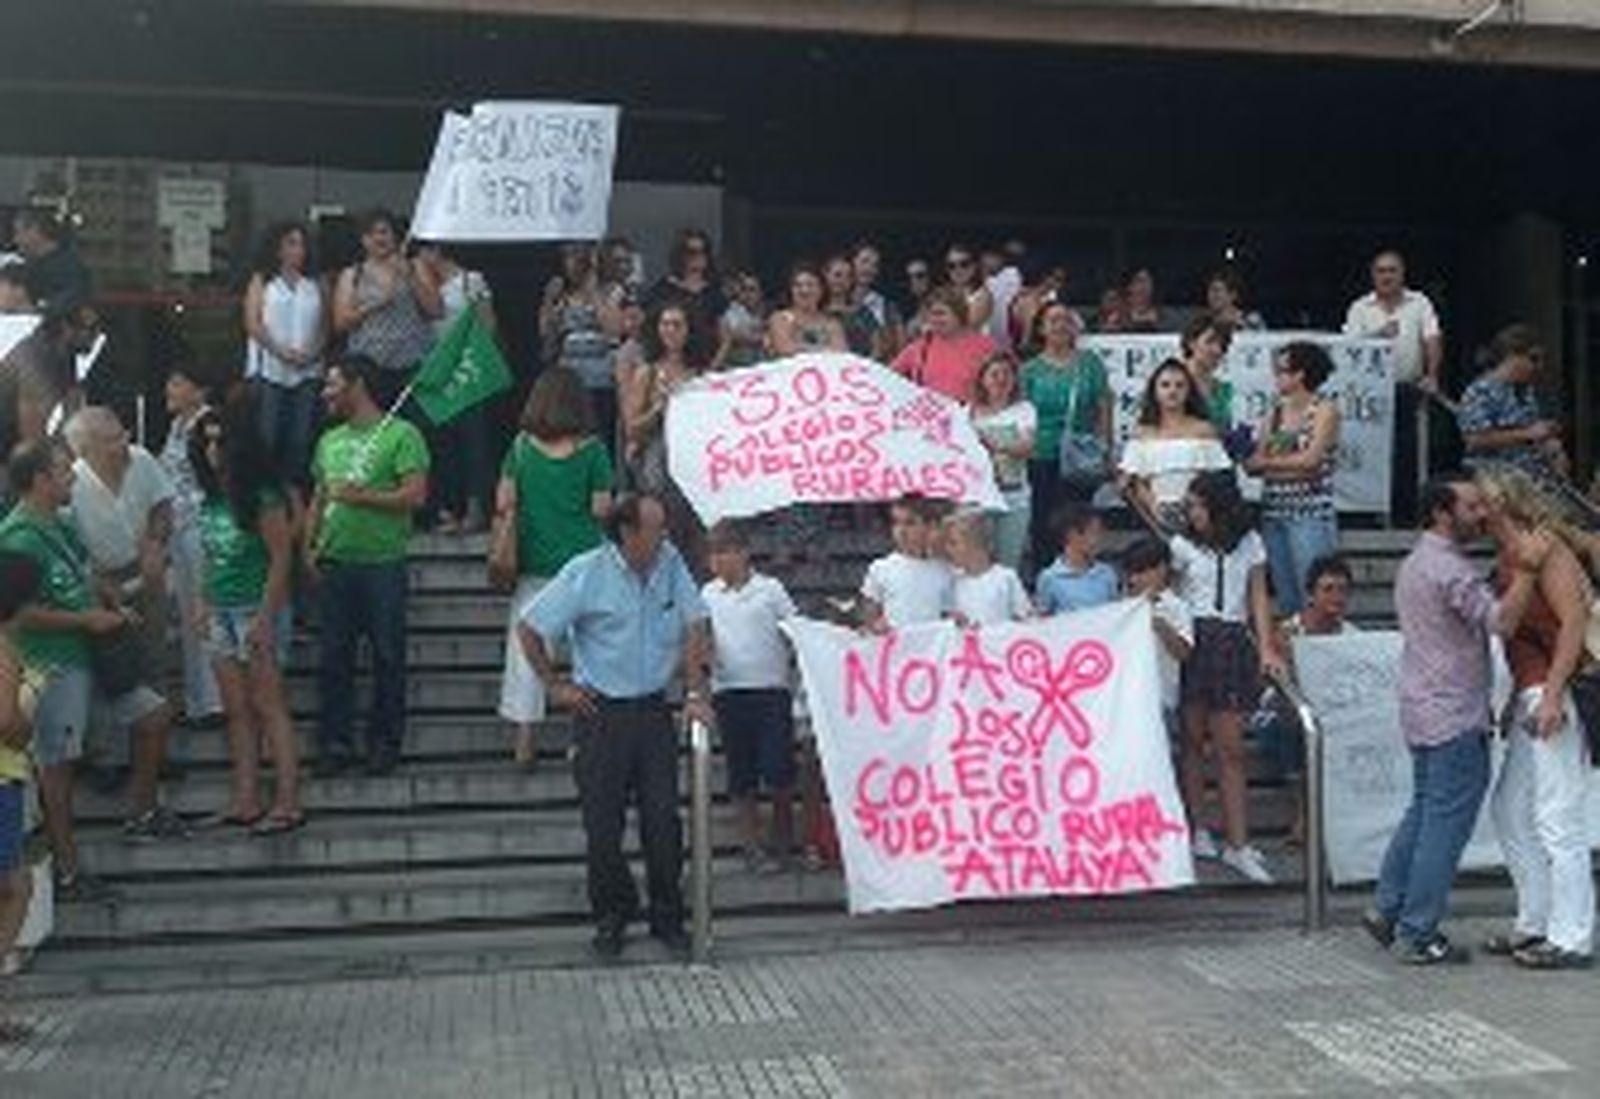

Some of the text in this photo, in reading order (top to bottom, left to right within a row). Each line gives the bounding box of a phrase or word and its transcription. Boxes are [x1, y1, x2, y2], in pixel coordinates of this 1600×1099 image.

[705, 410, 886, 454] COLEGIOS
[844, 630, 1006, 725] NO A
[949, 700, 1028, 758] LOS
[856, 750, 1099, 813] COLEGIO
